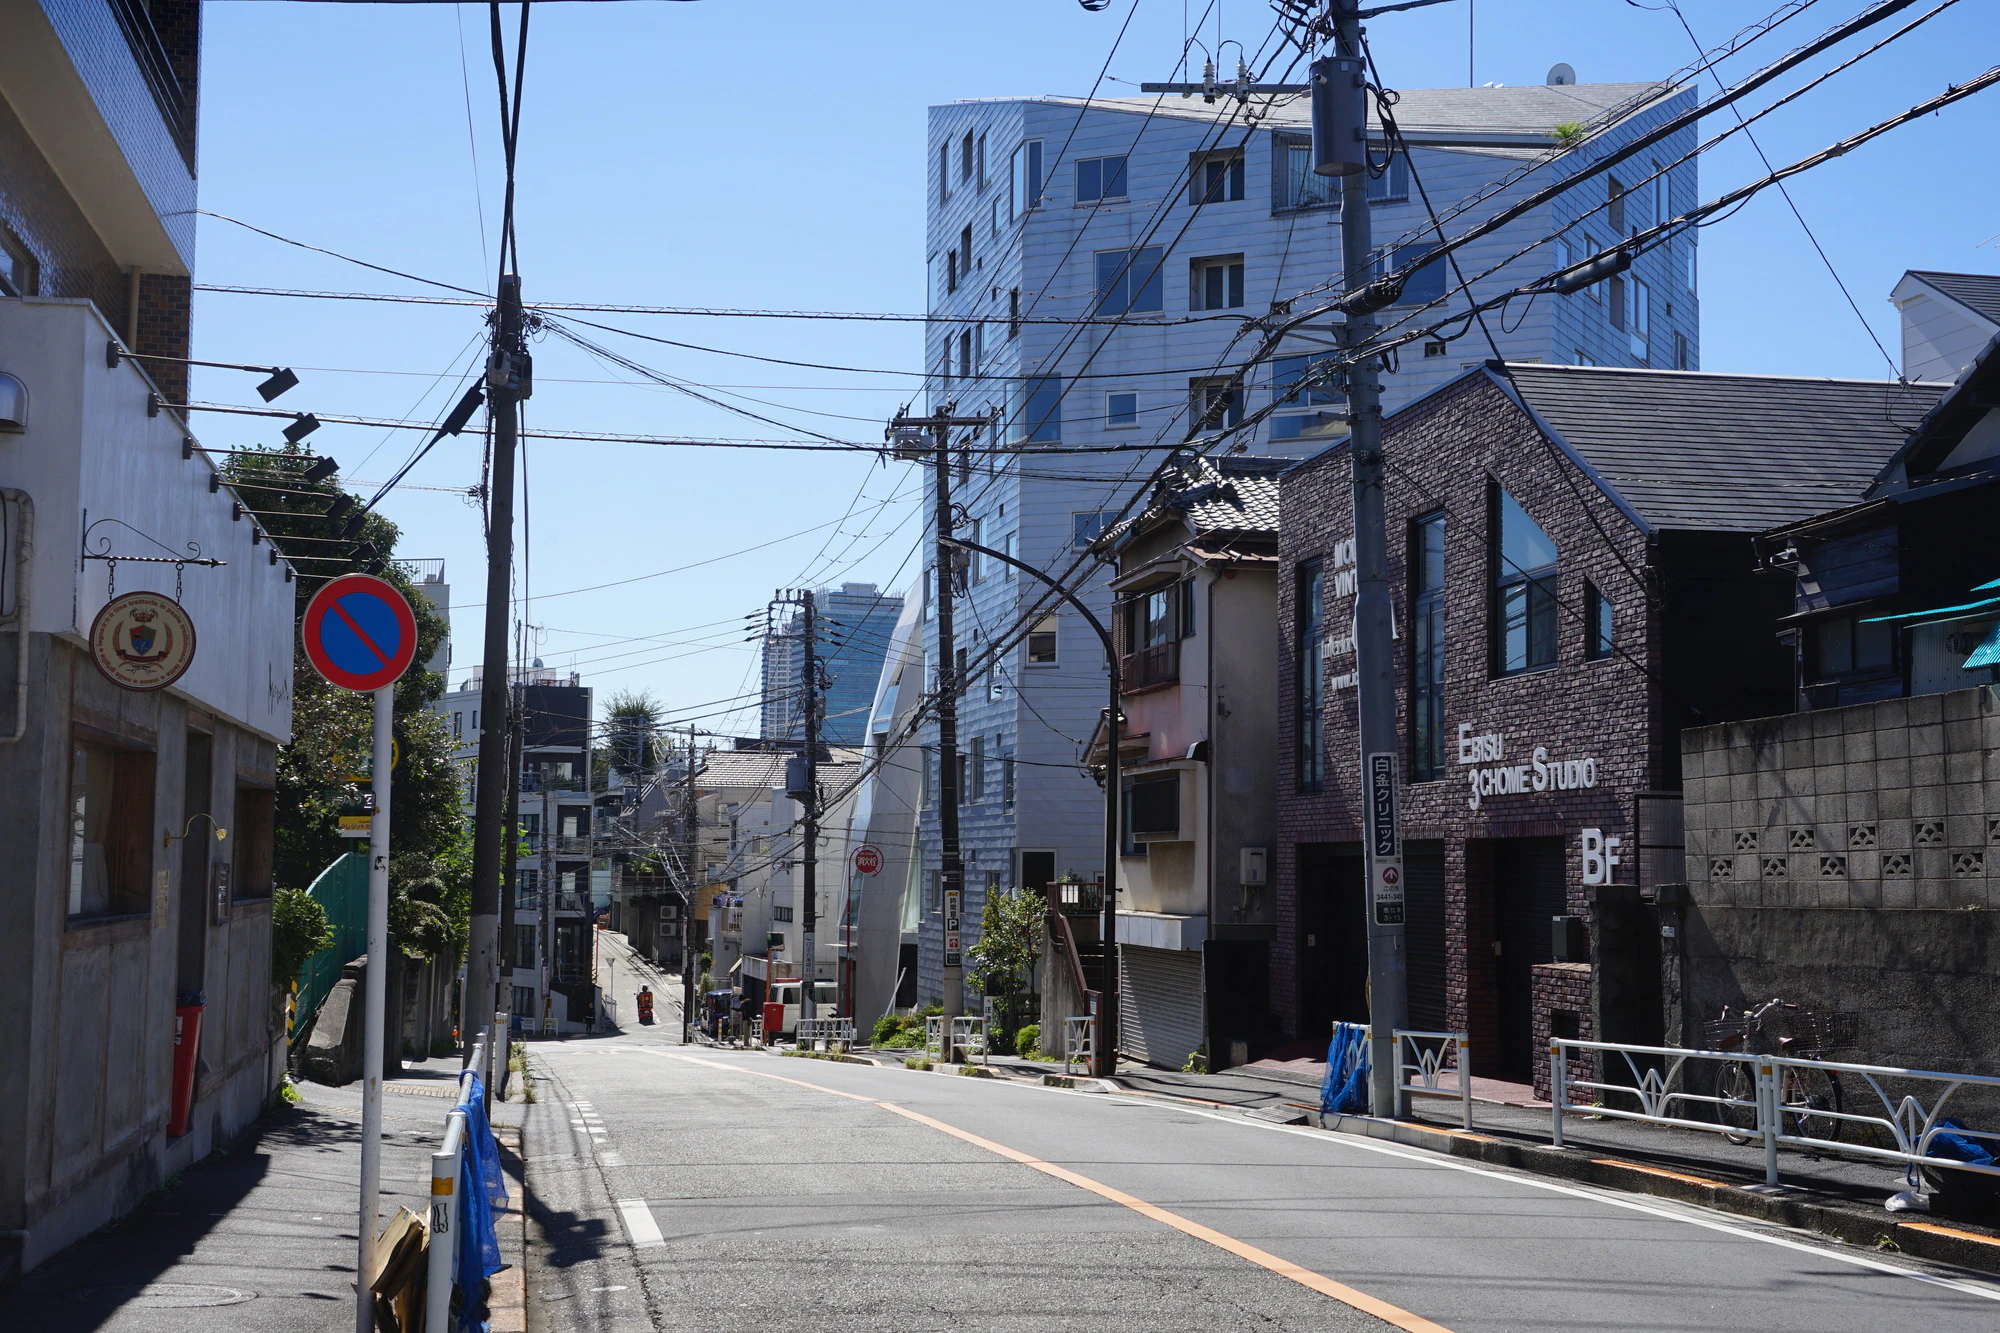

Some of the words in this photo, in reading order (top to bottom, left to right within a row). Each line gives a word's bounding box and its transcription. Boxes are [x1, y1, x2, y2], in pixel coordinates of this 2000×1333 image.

[1458, 723, 1504, 764] EBISU
[1532, 747, 1596, 792] STUDIO
[1375, 758, 1392, 854] 白金クリニック
[857, 856, 877, 866] 消火栓
[1582, 828, 1621, 885] BF
[949, 919, 958, 930] P
